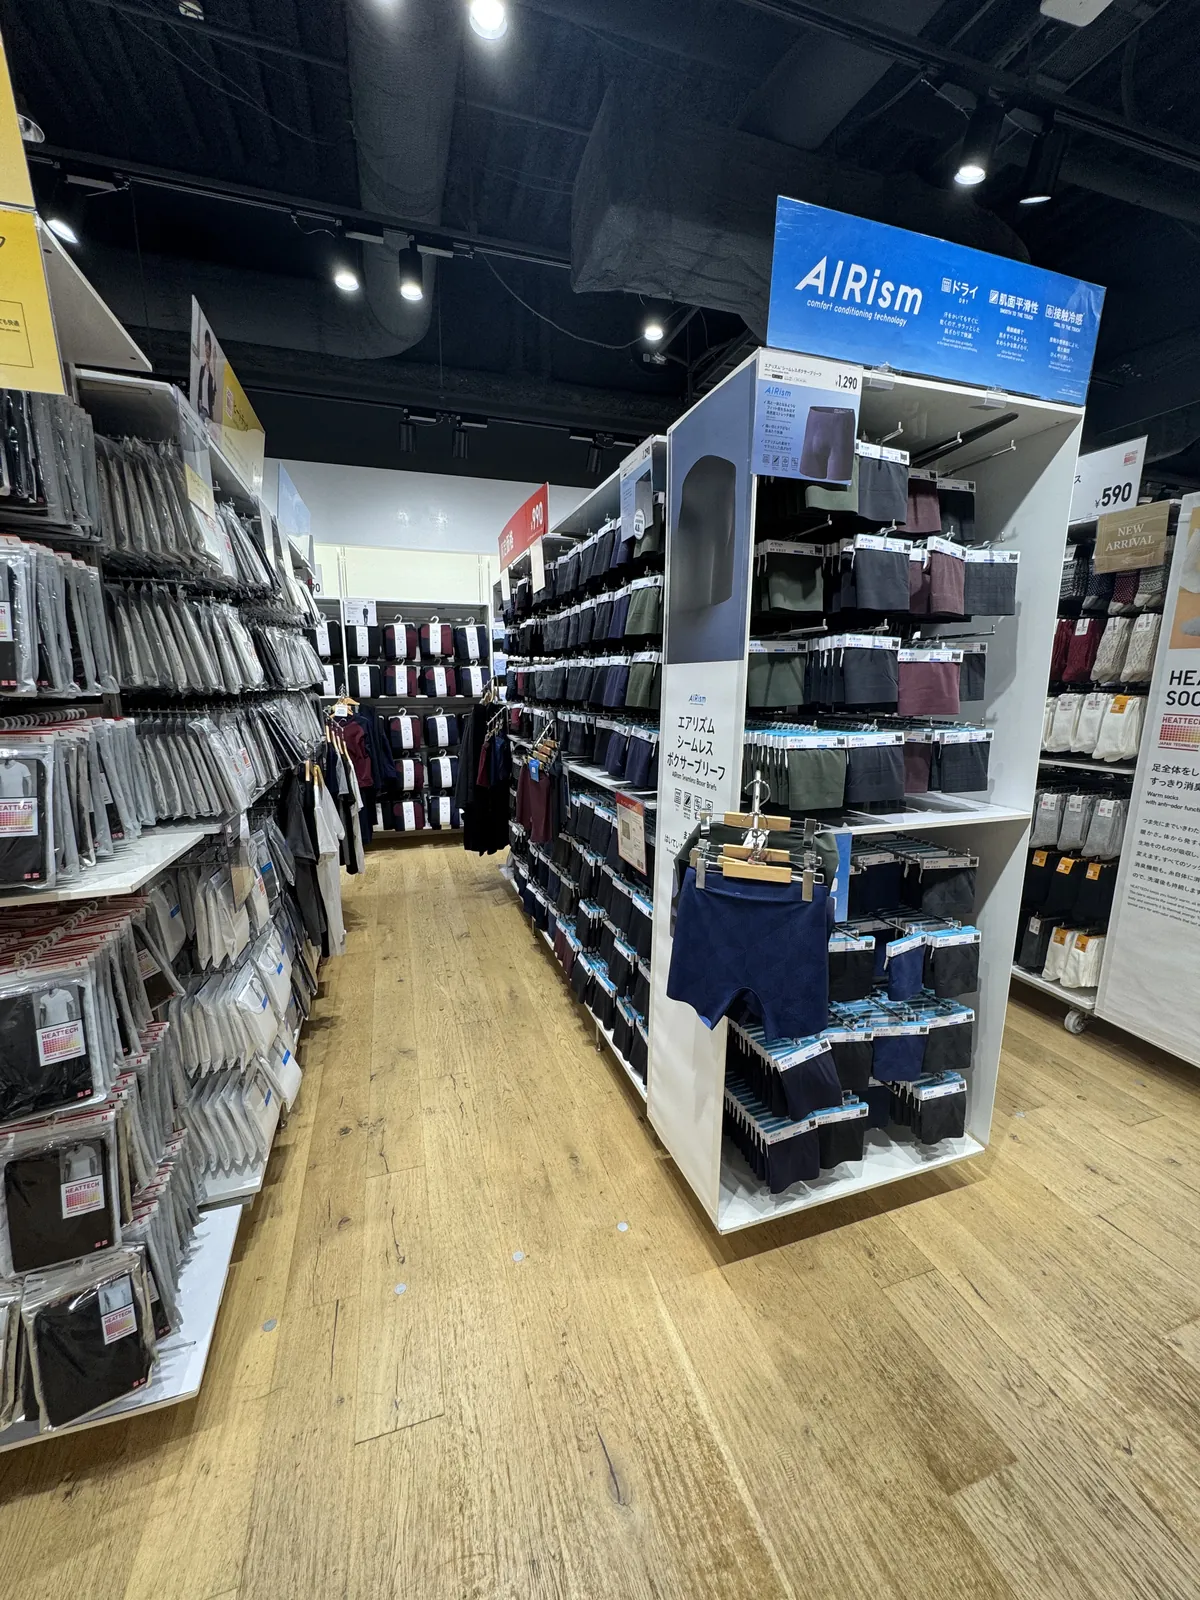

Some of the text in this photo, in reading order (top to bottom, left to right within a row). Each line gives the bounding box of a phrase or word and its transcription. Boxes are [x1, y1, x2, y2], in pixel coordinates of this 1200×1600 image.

[794, 255, 923, 315] AIRism
[952, 280, 978, 299] ドライ
[999, 292, 1039, 314] 肌面平滑性
[806, 299, 908, 327] comfort conditioning technology
[1053, 307, 1084, 326] 接触冷感
[836, 374, 858, 390] ¥1,290
[764, 386, 792, 397] AIRism
[1094, 482, 1132, 508] ¥590
[1118, 524, 1144, 537] NEW
[1105, 535, 1155, 552] ARRIVAL
[678, 716, 715, 735] エアリズム
[1162, 716, 1200, 726] HEATTEC
[676, 735, 714, 756] シームレス
[666, 752, 726, 782] ボクサーブリーフ
[1147, 790, 1164, 799] Warm
[42, 1026, 79, 1040] HEATTECH
[65, 1182, 100, 1194] HEATTECH
[104, 1310, 132, 1324] HEATTECH
